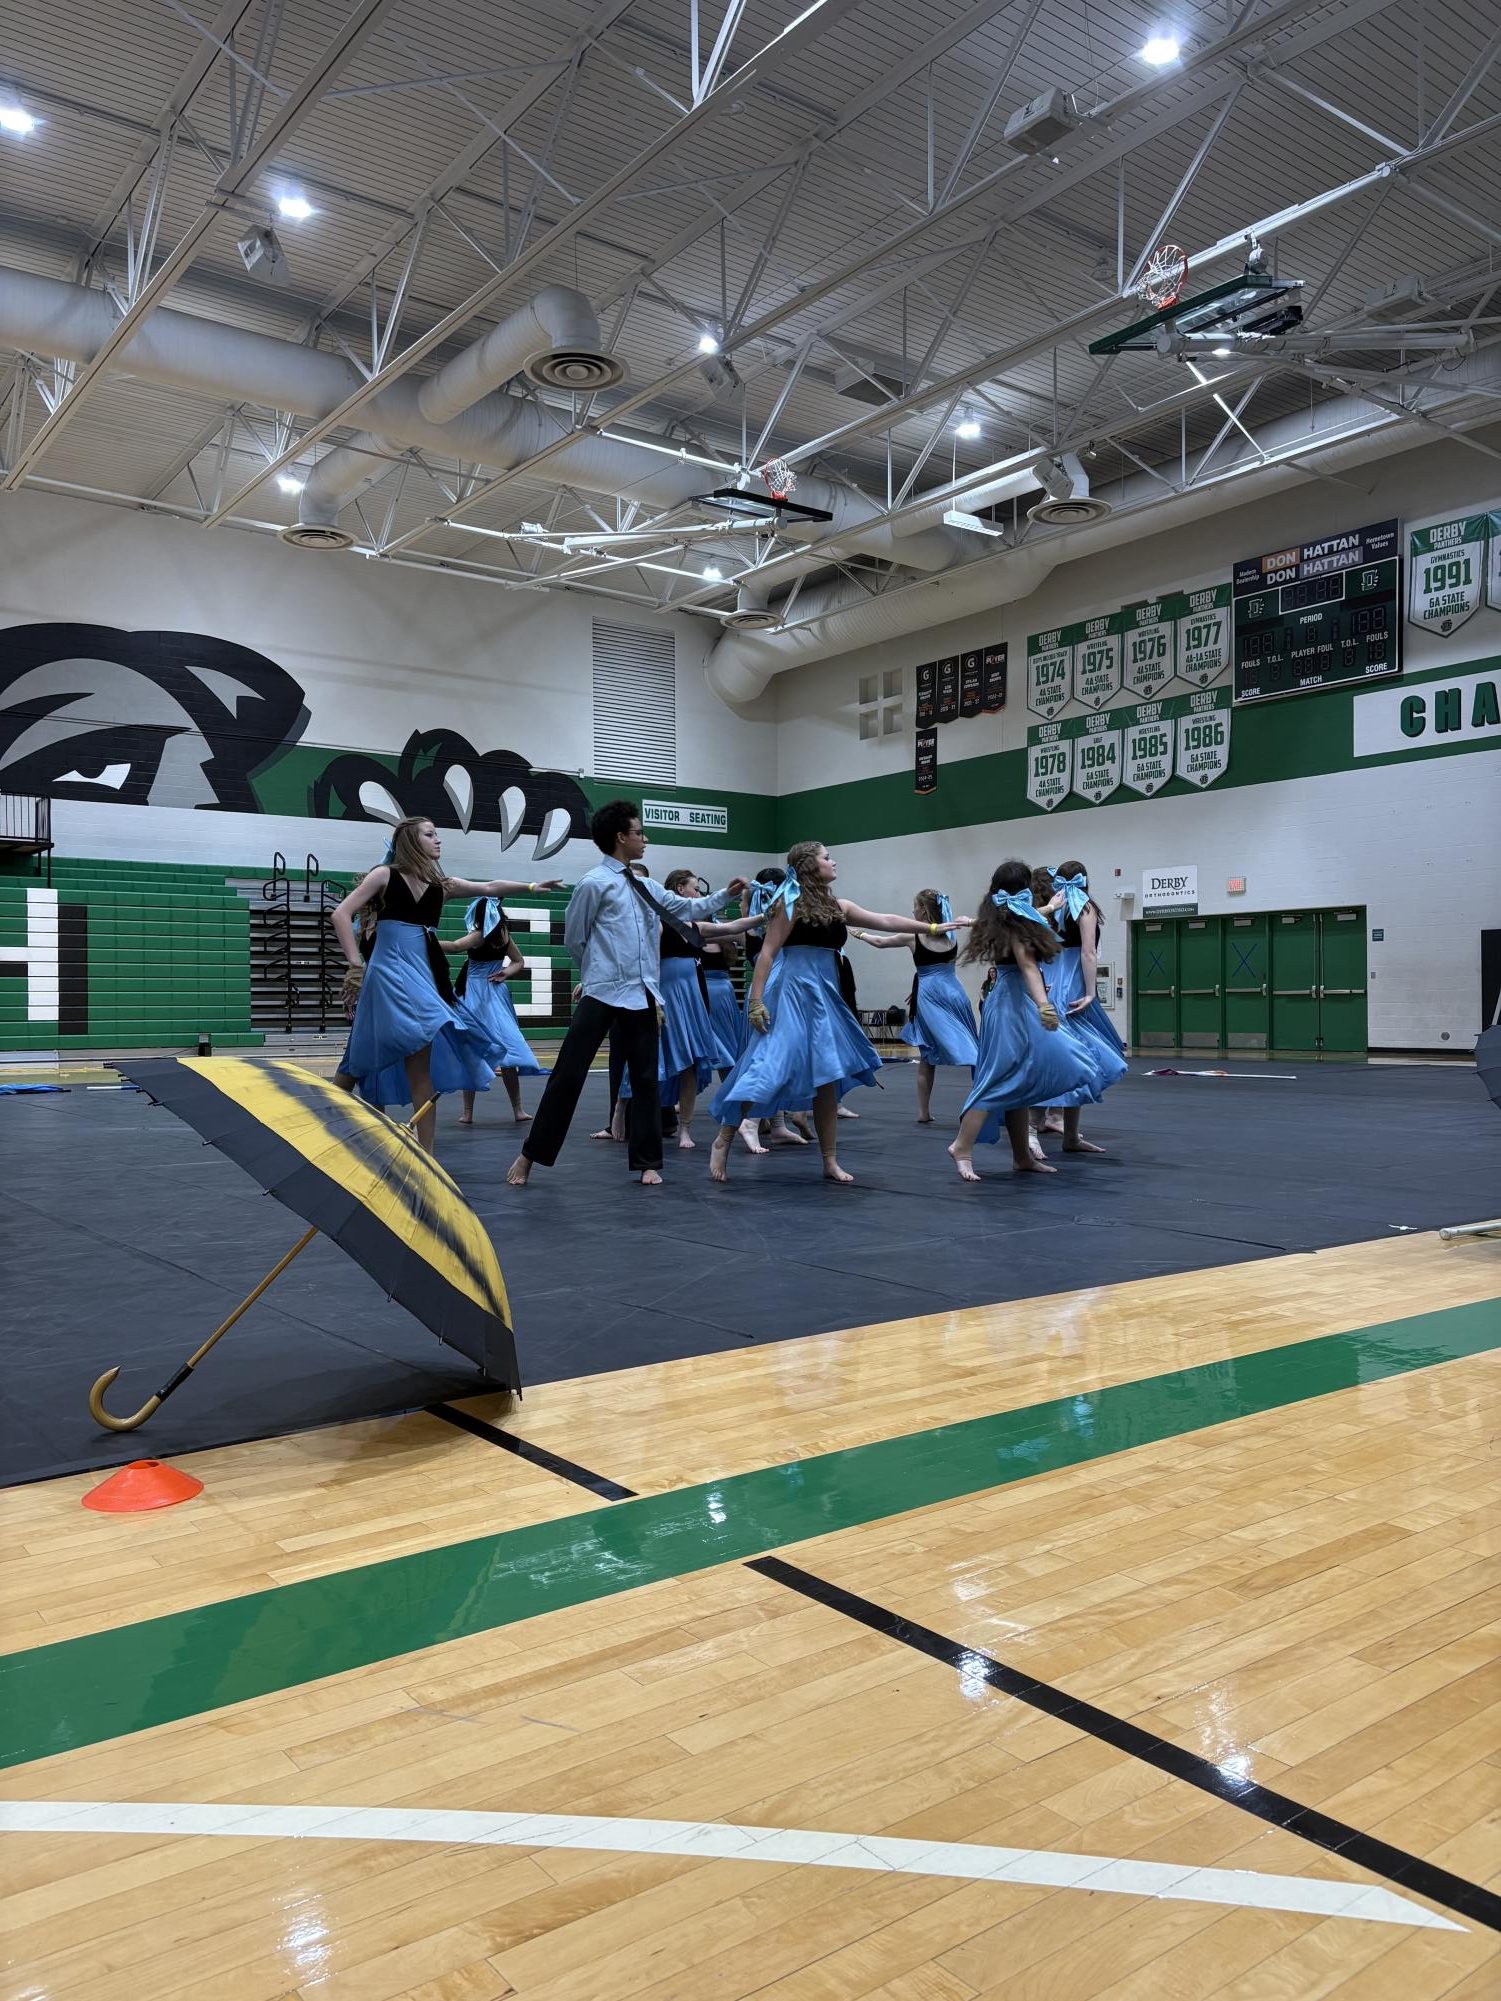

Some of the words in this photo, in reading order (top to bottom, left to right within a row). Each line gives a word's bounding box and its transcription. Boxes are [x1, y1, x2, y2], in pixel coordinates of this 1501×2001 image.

[1430, 521, 1466, 543] DERBY
[1434, 538, 1462, 550] PANTHERS
[1267, 552, 1296, 570] DON
[1303, 534, 1359, 560] HATTAN
[1431, 549, 1465, 564] GYMNASTICS
[1266, 567, 1296, 584] DON
[1303, 551, 1359, 576] HATTAN
[1423, 558, 1472, 594] 1991
[1189, 588, 1217, 608] DERBY
[1429, 597, 1440, 608] 6A
[1442, 591, 1465, 605] STATE
[1136, 604, 1162, 621] DERBY
[1423, 601, 1470, 620] CHAMPIONS
[1085, 617, 1110, 634] DERBY
[1300, 613, 1323, 624] PERIOD
[1038, 630, 1062, 646] DERBY
[1185, 621, 1222, 651] 1977
[1132, 634, 1167, 663] 1976
[1205, 648, 1221, 660] STATE
[1241, 658, 1261, 669] FOULS
[1291, 647, 1315, 658] PLAYER
[1317, 643, 1334, 653] FOUL
[1341, 639, 1359, 648] T.O.L.
[1366, 631, 1388, 643] FOULS
[943, 663, 952, 673] G
[967, 656, 975, 667] G
[1081, 648, 1114, 675] 1975
[1144, 662, 1161, 672] STATE
[1186, 658, 1222, 673] CHAMPIONS
[923, 670, 930, 680] G
[1035, 659, 1066, 686] 1974
[1094, 674, 1109, 684] STATE
[1133, 670, 1165, 685] CHAMPIONS
[1241, 687, 1261, 697] SCORE
[1300, 675, 1322, 686] MATCH
[1365, 663, 1388, 674] SCORE
[1046, 685, 1062, 695] STATE
[1081, 682, 1113, 695] CHAMPIONS
[1035, 693, 1065, 706] CHAMPIONS
[1190, 690, 1218, 707] DERBY
[1136, 702, 1162, 718] DERBY
[1193, 703, 1215, 713] PANTHERS
[1086, 713, 1111, 729] DERBY
[1038, 722, 1062, 738] DERBY
[1184, 722, 1225, 751] 1986
[1131, 732, 1168, 760] 1985
[1080, 742, 1116, 769] 1984
[1191, 754, 1198, 763] 6A
[1200, 751, 1217, 762] STATE
[1034, 751, 1066, 778] 1978
[1137, 763, 1144, 772] 6A
[1145, 760, 1162, 771] STATE
[1186, 759, 1222, 773] CHAMPIONS
[1094, 769, 1109, 779] STATE
[1133, 769, 1166, 782] CHAMPIONS
[1046, 777, 1061, 787] STATE
[1082, 777, 1114, 790] CHAMPIONS
[1035, 785, 1065, 798] CHAMPIONS
[645, 808, 680, 821] VISITOR
[689, 812, 726, 825] SEATING
[1151, 877, 1189, 890] DERBY
[1145, 890, 1195, 898] ORTHODONTICS
